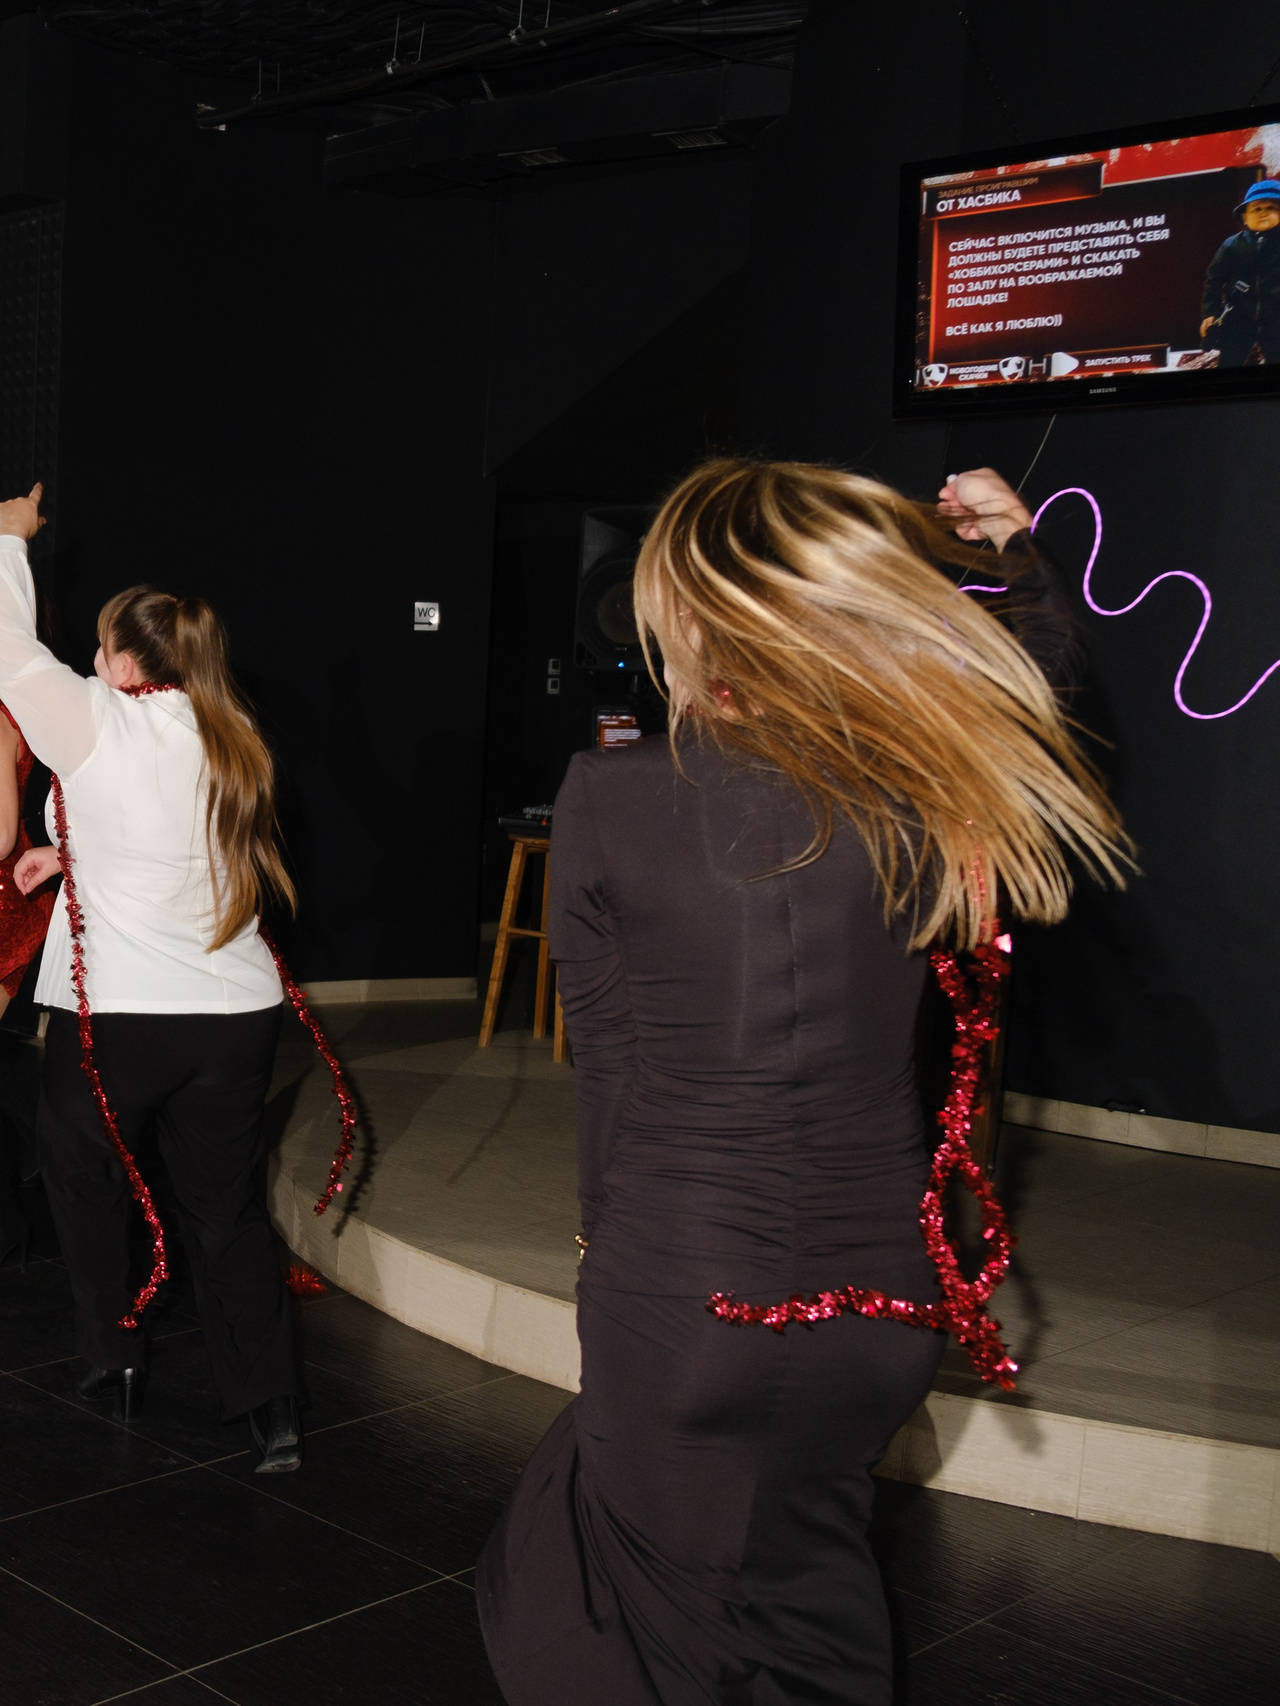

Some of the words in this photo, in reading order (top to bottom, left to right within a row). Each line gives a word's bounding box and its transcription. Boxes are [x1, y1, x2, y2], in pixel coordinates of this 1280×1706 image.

[936, 199, 956, 213] ОТ
[957, 189, 1022, 210] ХАСБИКА
[938, 186, 974, 198] ЗАДАНИЕ
[948, 237, 996, 252] СЕЙЧАС
[997, 226, 1073, 246] ВКЛЮЧИТСЯ
[1074, 219, 1131, 236] МУЗЫКА,
[1132, 217, 1143, 229] И
[1144, 214, 1166, 227] ВЫ
[947, 250, 1002, 268] ДОЛЖНЫ
[1003, 244, 1047, 260] БУДЕТЕ
[1047, 233, 1135, 254] ПРЕДСТАВИТЬ
[1136, 228, 1170, 243] СЕБЯ
[947, 257, 1069, 280] «ХОББИХОРСЕРАМИ»
[1071, 254, 1081, 266] И
[1082, 247, 1141, 264] СКАКАТЬ
[947, 283, 966, 295] ПО
[966, 279, 997, 293] ЗАЛУ
[998, 277, 1016, 289] НА
[1017, 262, 1123, 287] ВООБРАЖАЕМОЙ
[946, 292, 1009, 309] ЛОШАДКЕ!
[945, 323, 968, 336] ВСЁ
[969, 322, 993, 334] КАК
[994, 321, 1003, 332] Я
[1005, 313, 1063, 331] ЛЮБЛЮ))
[1084, 356, 1131, 367] ЗАПУСТИТЬ
[1131, 353, 1152, 363] ТРЕК
[1089, 387, 1117, 395] SAMSUNG
[417, 607, 436, 618] WC
